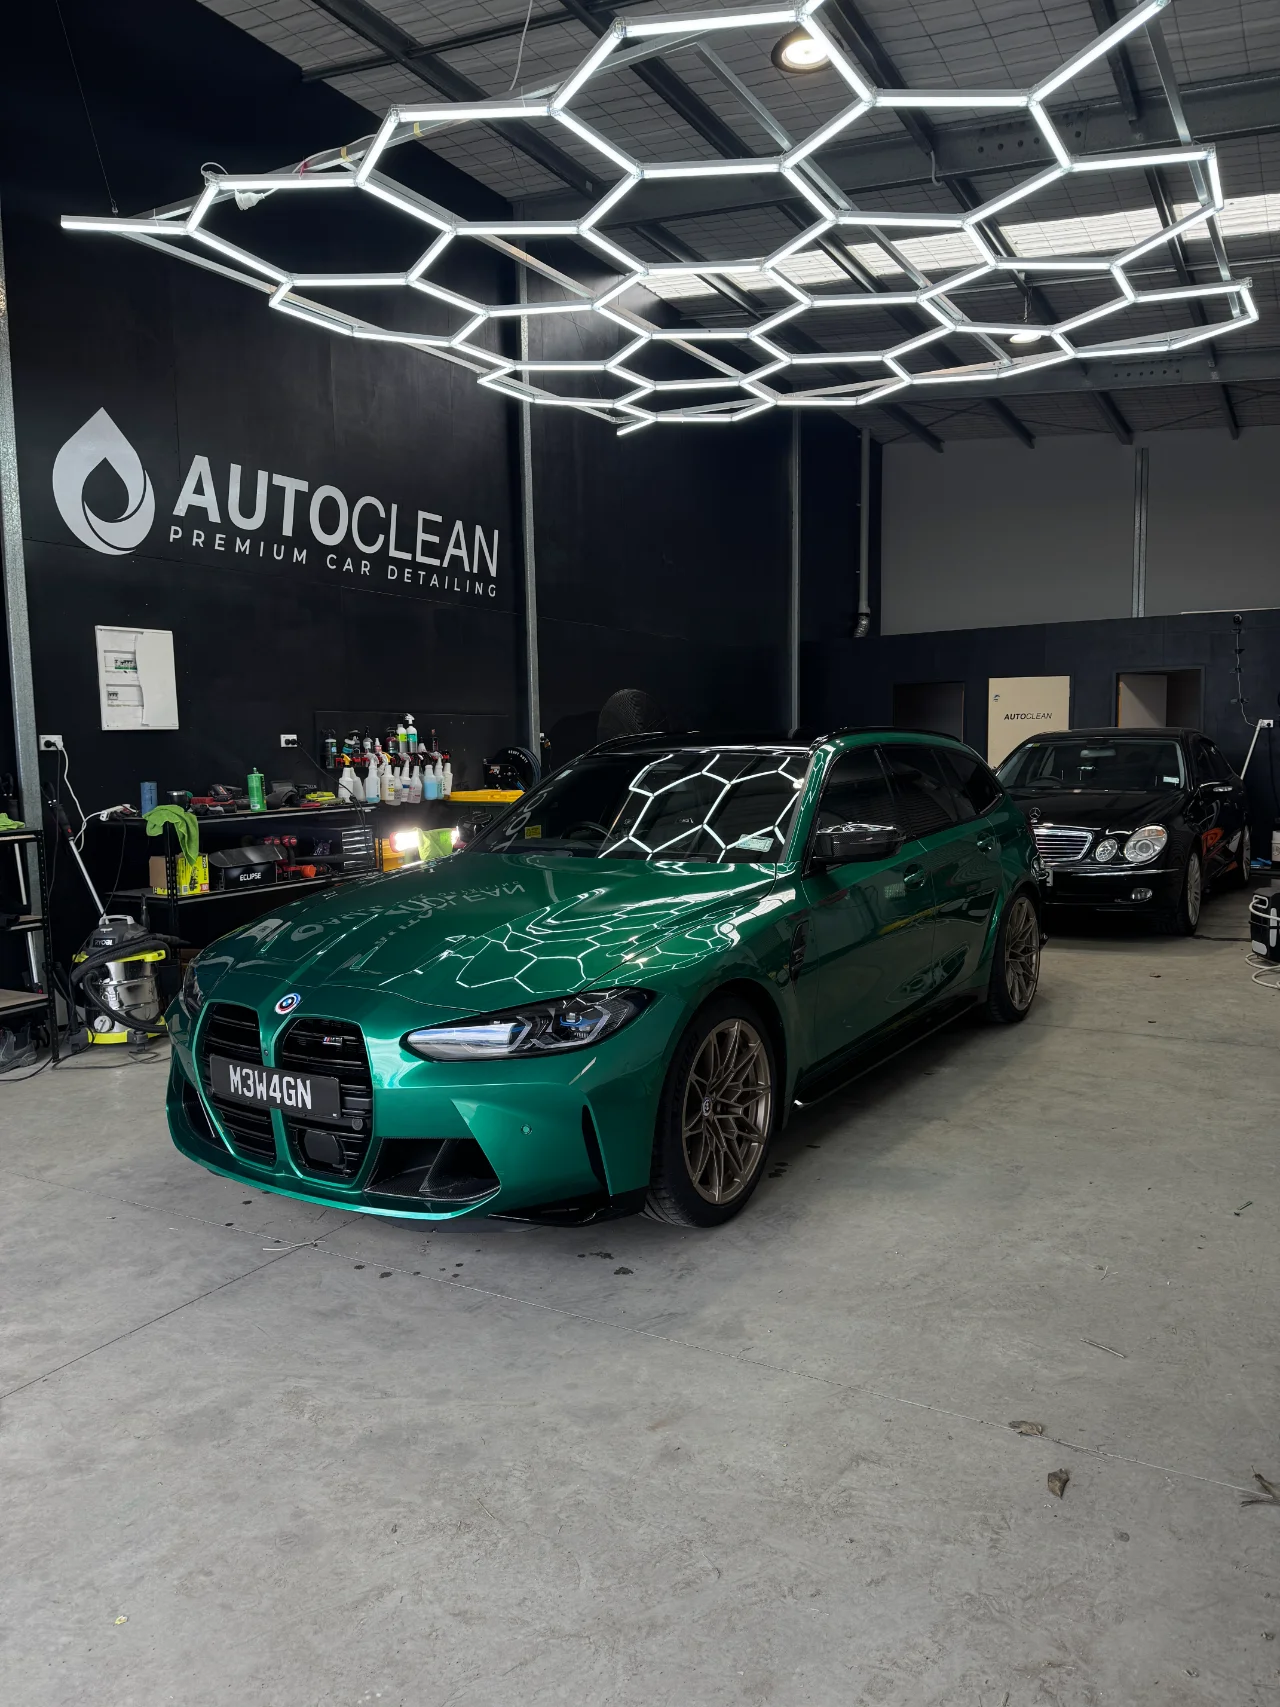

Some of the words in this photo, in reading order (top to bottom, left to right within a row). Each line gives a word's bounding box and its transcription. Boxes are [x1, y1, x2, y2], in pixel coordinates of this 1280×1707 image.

[173, 455, 499, 577] AUTOCLEAN
[169, 525, 307, 565] PREMIUM
[326, 553, 371, 576] CAR
[387, 565, 497, 597] DETAILING
[1004, 712, 1053, 720] AUTOCLEAN
[239, 872, 262, 882] ECLIPSE
[229, 1064, 312, 1110] M3W4GN
